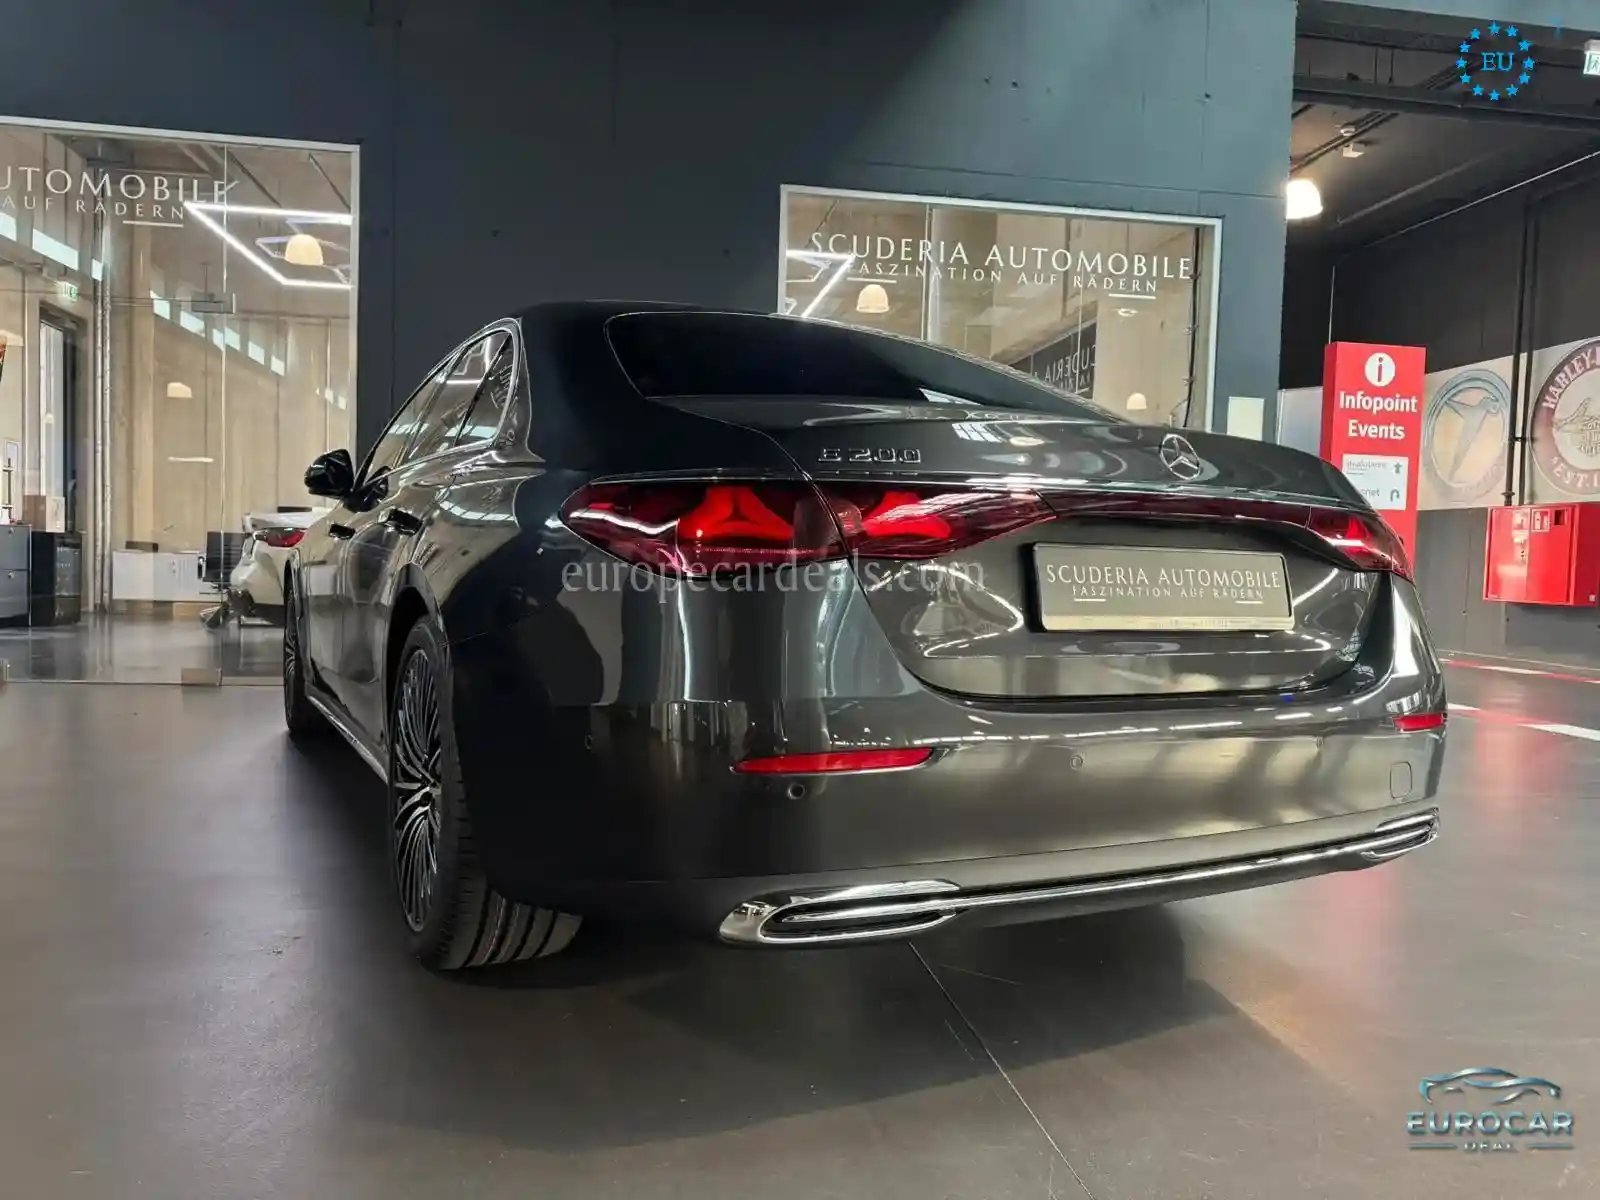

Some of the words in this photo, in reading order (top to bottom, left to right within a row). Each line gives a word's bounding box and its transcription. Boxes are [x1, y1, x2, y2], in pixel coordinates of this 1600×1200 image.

[2, 194, 54, 212] AUF
[811, 231, 969, 266] SCUDERIA
[984, 243, 1191, 280] AUTOMOBILE
[1017, 272, 1057, 286] AUF
[1339, 390, 1418, 415] Infopoint
[1348, 419, 1406, 441] Events
[848, 448, 921, 463] 200
[1046, 564, 1150, 585] SCUDERIA
[1158, 567, 1281, 589] AUTOMOBILE
[1072, 585, 1172, 599] FASZINATION
